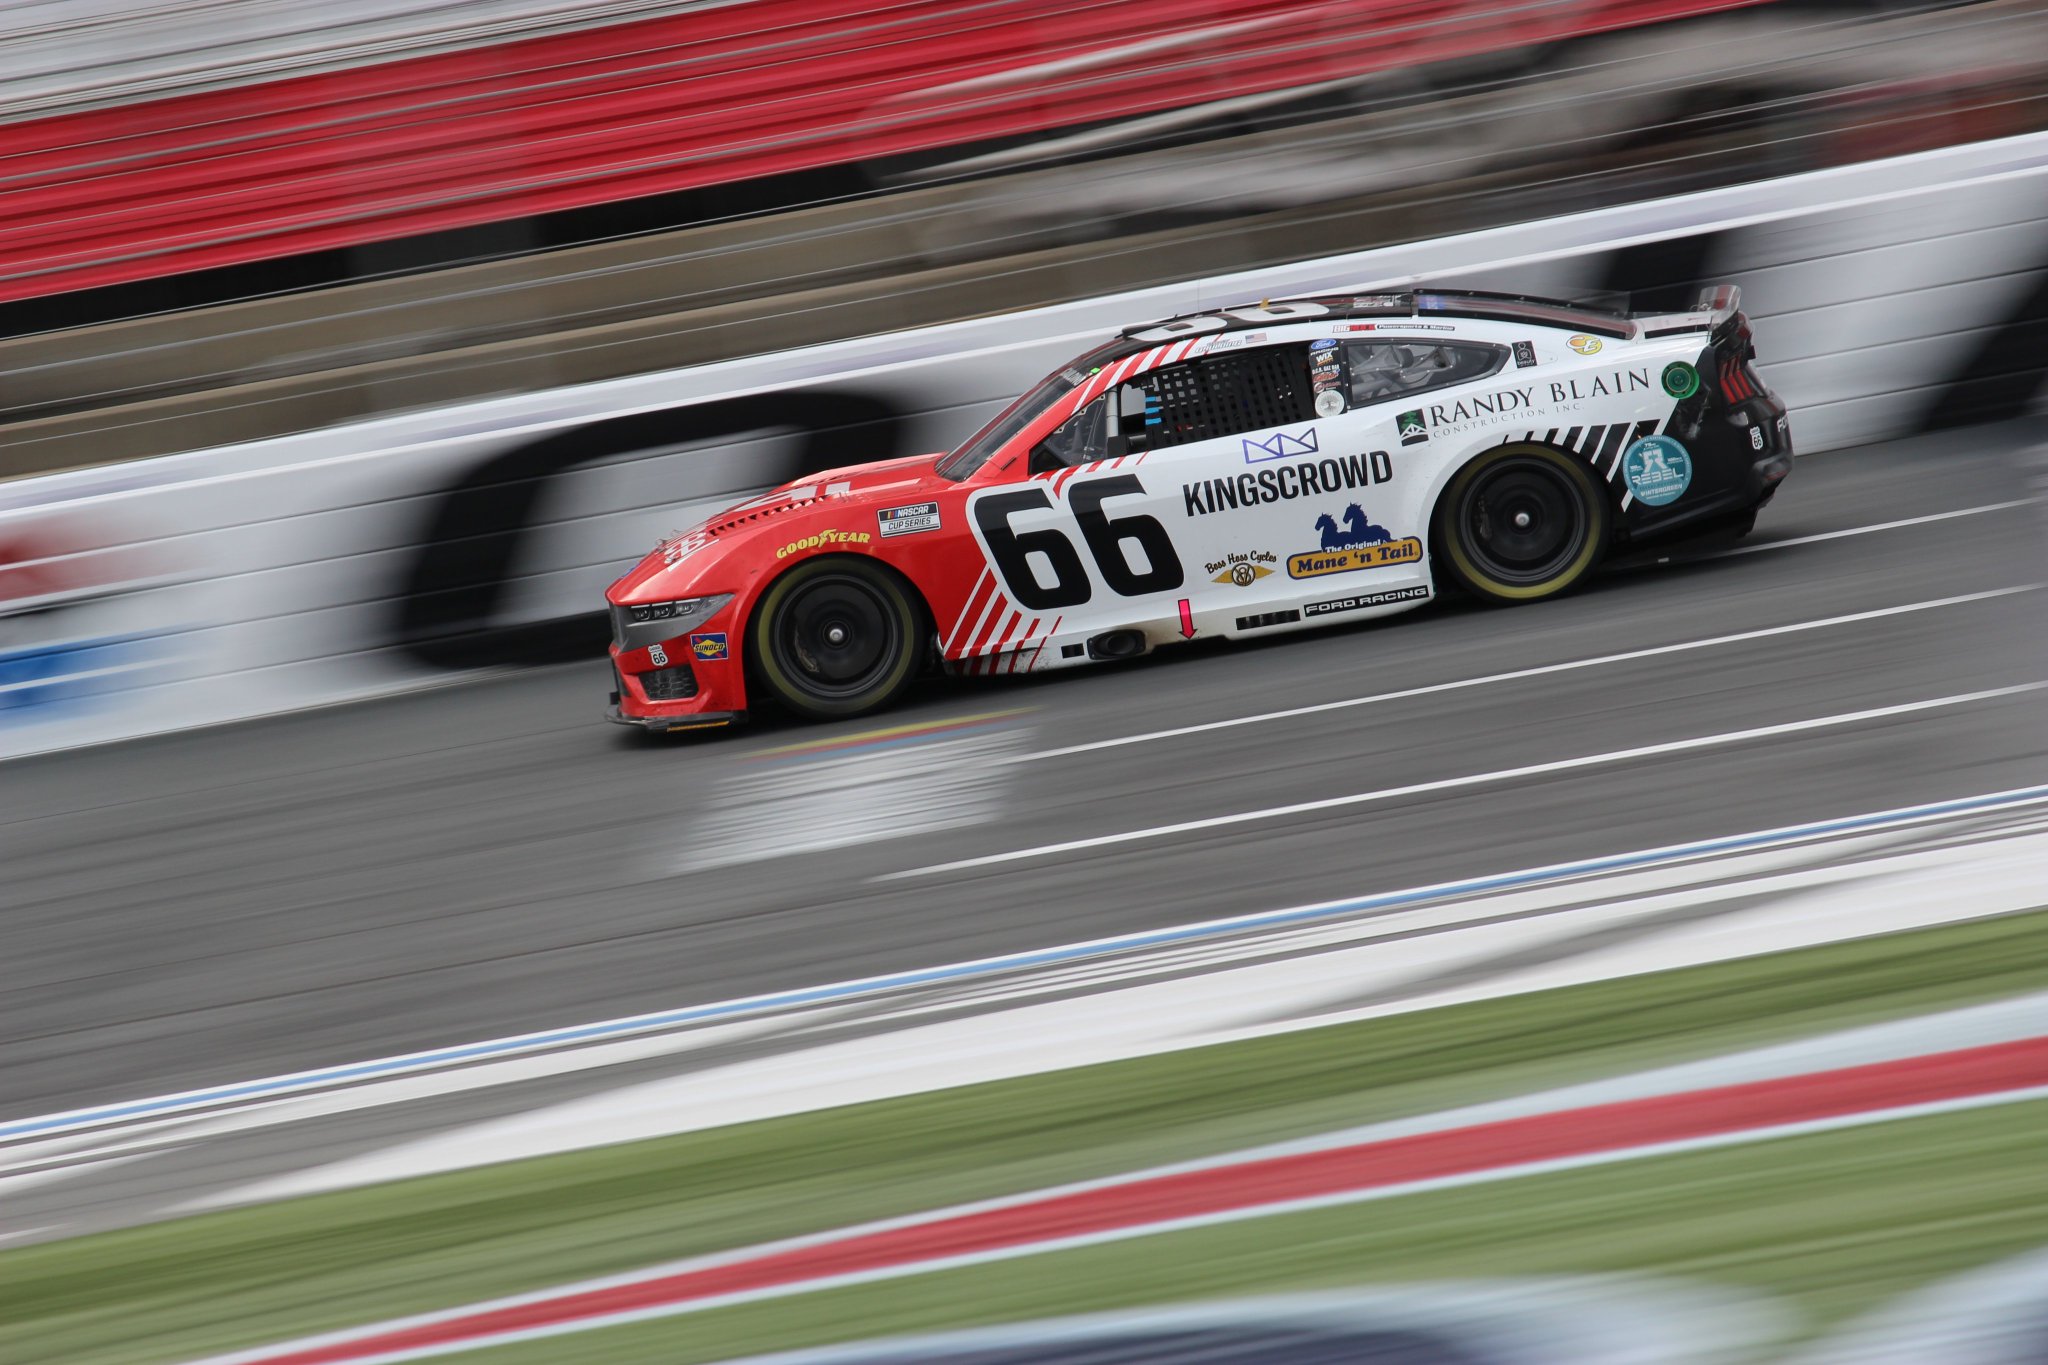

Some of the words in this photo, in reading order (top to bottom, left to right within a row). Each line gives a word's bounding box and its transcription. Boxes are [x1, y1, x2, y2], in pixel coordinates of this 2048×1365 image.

[1316, 351, 1333, 363] WIX
[1429, 387, 1534, 427] RANDY
[1549, 368, 1650, 402] BLAIN
[1433, 408, 1546, 439] CONSTRUCTION
[1556, 403, 1585, 414] INC.
[1182, 450, 1393, 517] KINGSCROWD
[1631, 467, 1684, 485] REBEL
[888, 519, 903, 530] CUP
[905, 517, 931, 528] SERIES
[898, 505, 929, 517] NASCAR
[776, 528, 870, 559] GOODYEAR
[974, 474, 1185, 610] 66
[1325, 545, 1342, 554] The
[1344, 539, 1381, 551] Original
[1204, 559, 1226, 575] Boss
[1250, 550, 1277, 563] Cycles
[1296, 556, 1347, 573] Mane
[1377, 543, 1414, 561] Tail
[1305, 599, 1356, 614] FORD
[1359, 587, 1428, 604] RACING
[652, 652, 666, 665] 66
[694, 643, 726, 652] SUNOCO
